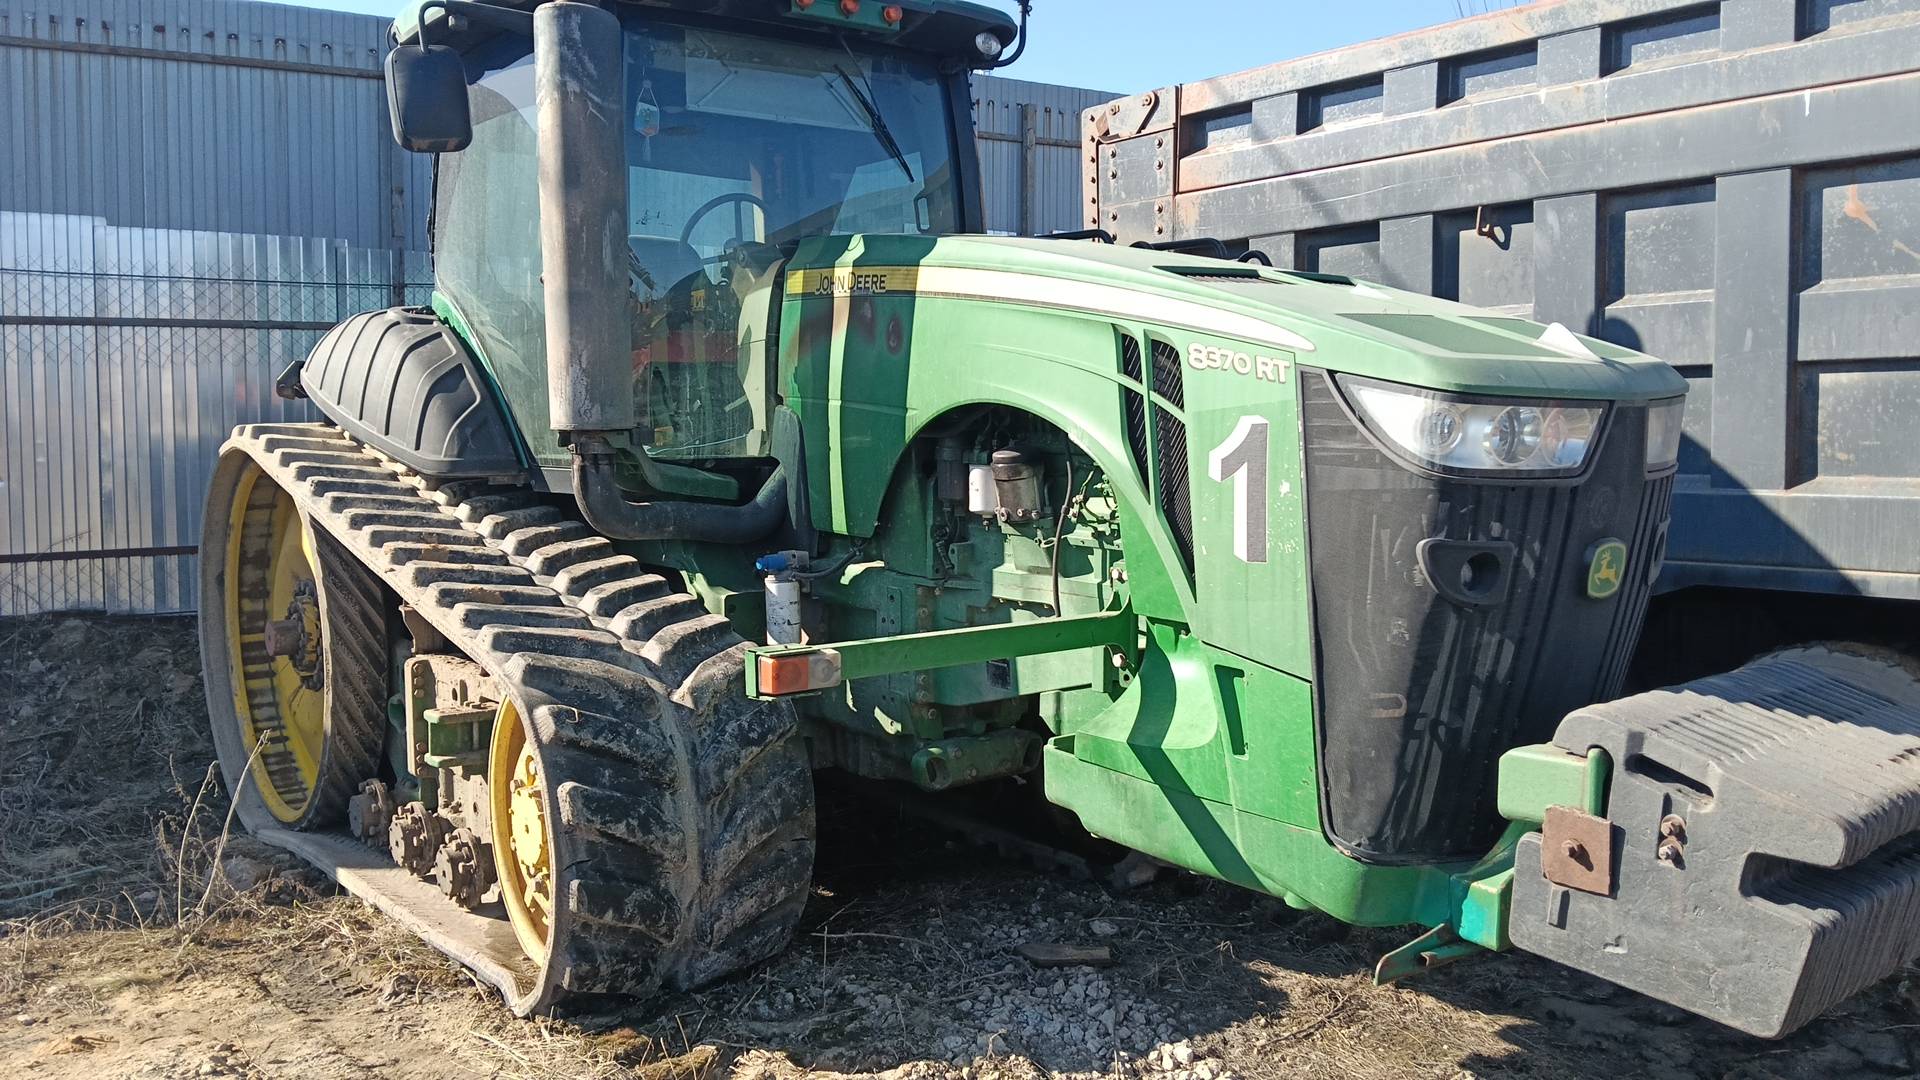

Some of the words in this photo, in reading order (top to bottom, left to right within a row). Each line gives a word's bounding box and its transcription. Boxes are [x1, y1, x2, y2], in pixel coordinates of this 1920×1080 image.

[815, 272, 846, 293] JOHN
[847, 271, 887, 292] DEERE
[1187, 342, 1252, 375] 8370
[1255, 355, 1290, 384] RT
[1207, 414, 1270, 563] 1
